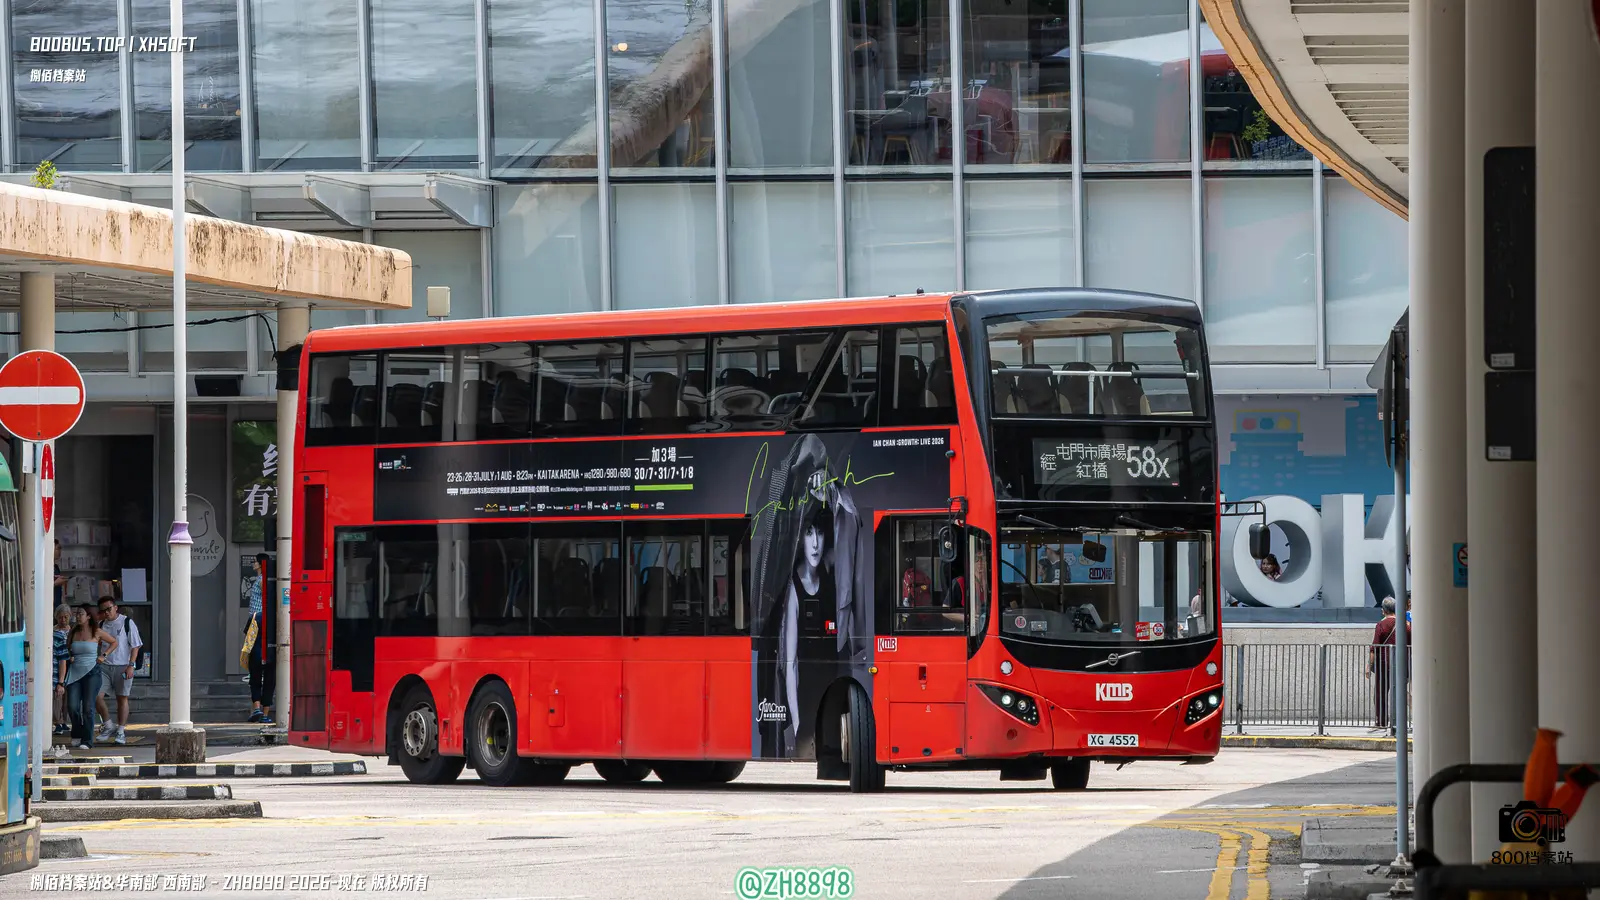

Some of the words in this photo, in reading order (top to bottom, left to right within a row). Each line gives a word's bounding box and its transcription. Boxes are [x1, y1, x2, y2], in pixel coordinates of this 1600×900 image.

[882, 439, 896, 447] CHAN
[931, 437, 945, 445] 2026
[1056, 443, 1126, 461] 屯門市廣場
[1040, 453, 1057, 471] 經
[1076, 461, 1108, 479] 紅橋
[242, 483, 277, 517] 有
[878, 638, 897, 651] KMB
[1095, 683, 1133, 701] KMB
[1090, 735, 1104, 745] XG
[1109, 735, 1136, 746] 4552
